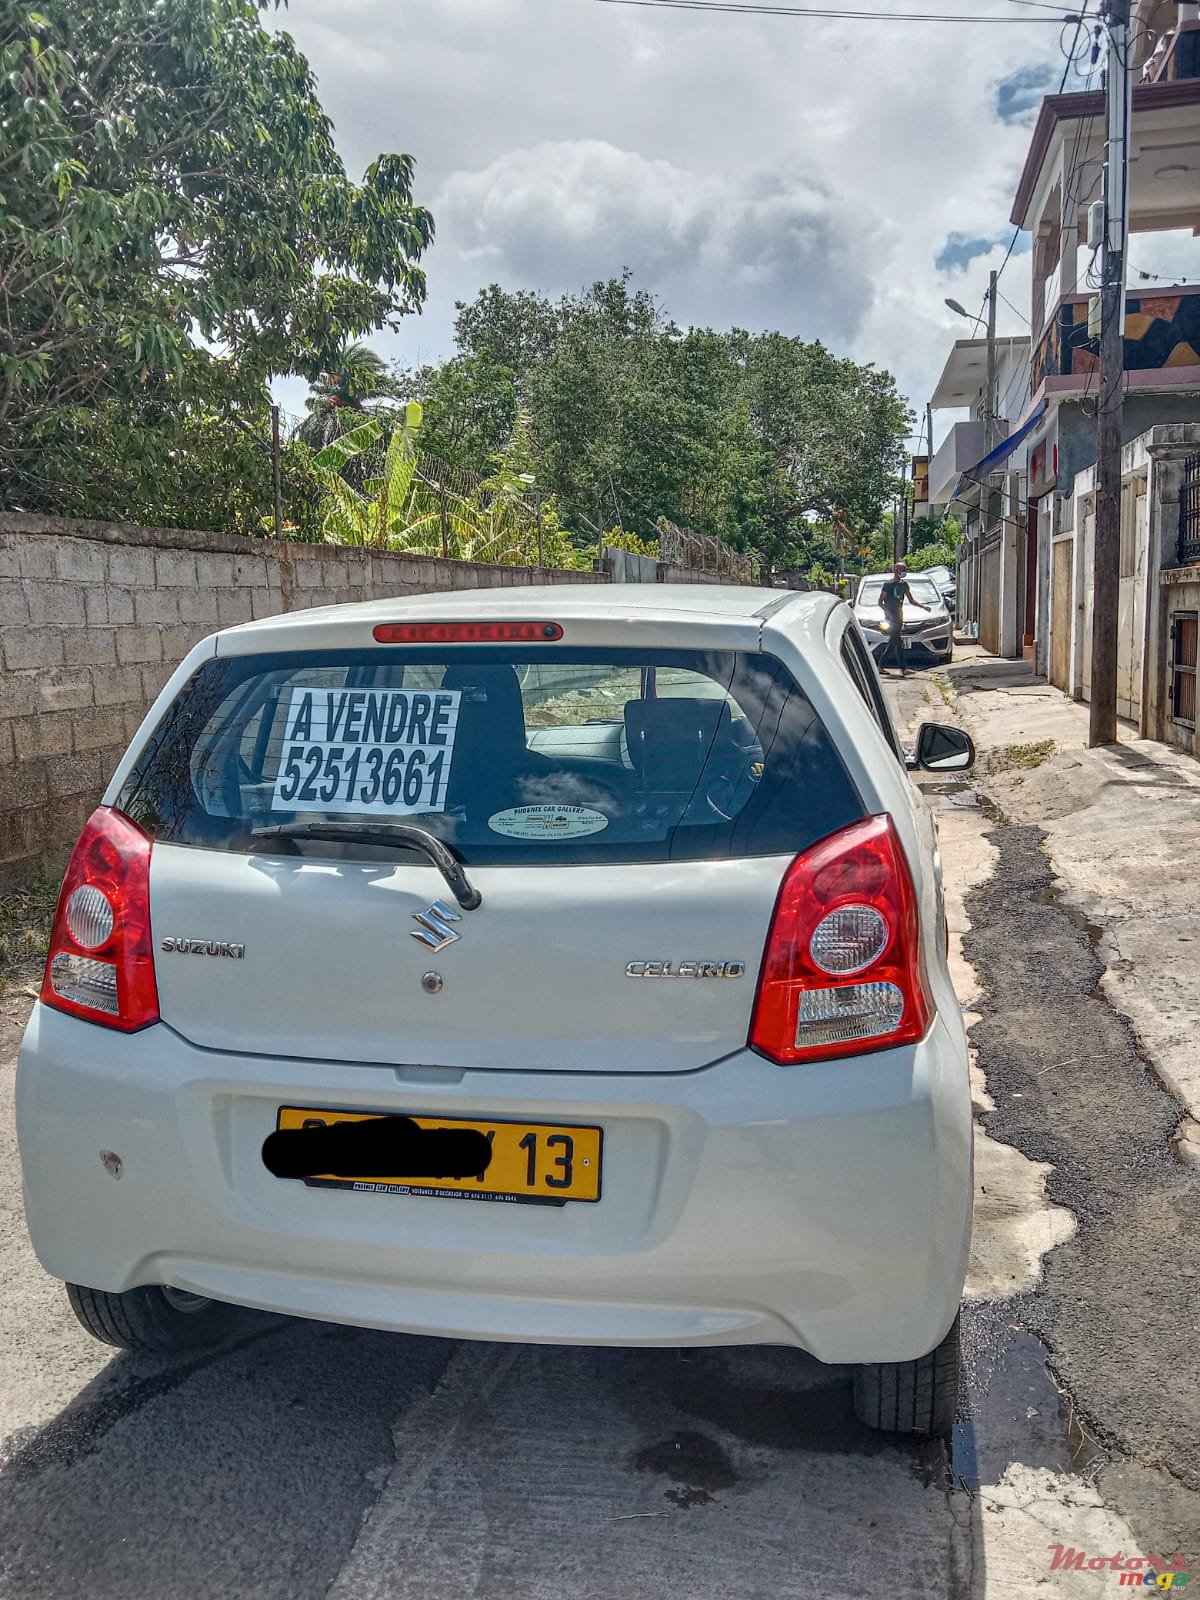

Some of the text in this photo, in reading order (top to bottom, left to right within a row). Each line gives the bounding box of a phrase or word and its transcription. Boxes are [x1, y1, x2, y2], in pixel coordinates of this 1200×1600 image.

[290, 692, 453, 745] A VENDRE
[280, 746, 445, 806] 52513661
[557, 806, 585, 814] GALLERY
[161, 936, 246, 960] SUZUKI
[625, 960, 746, 978] CELERIO
[518, 1132, 574, 1189] 13
